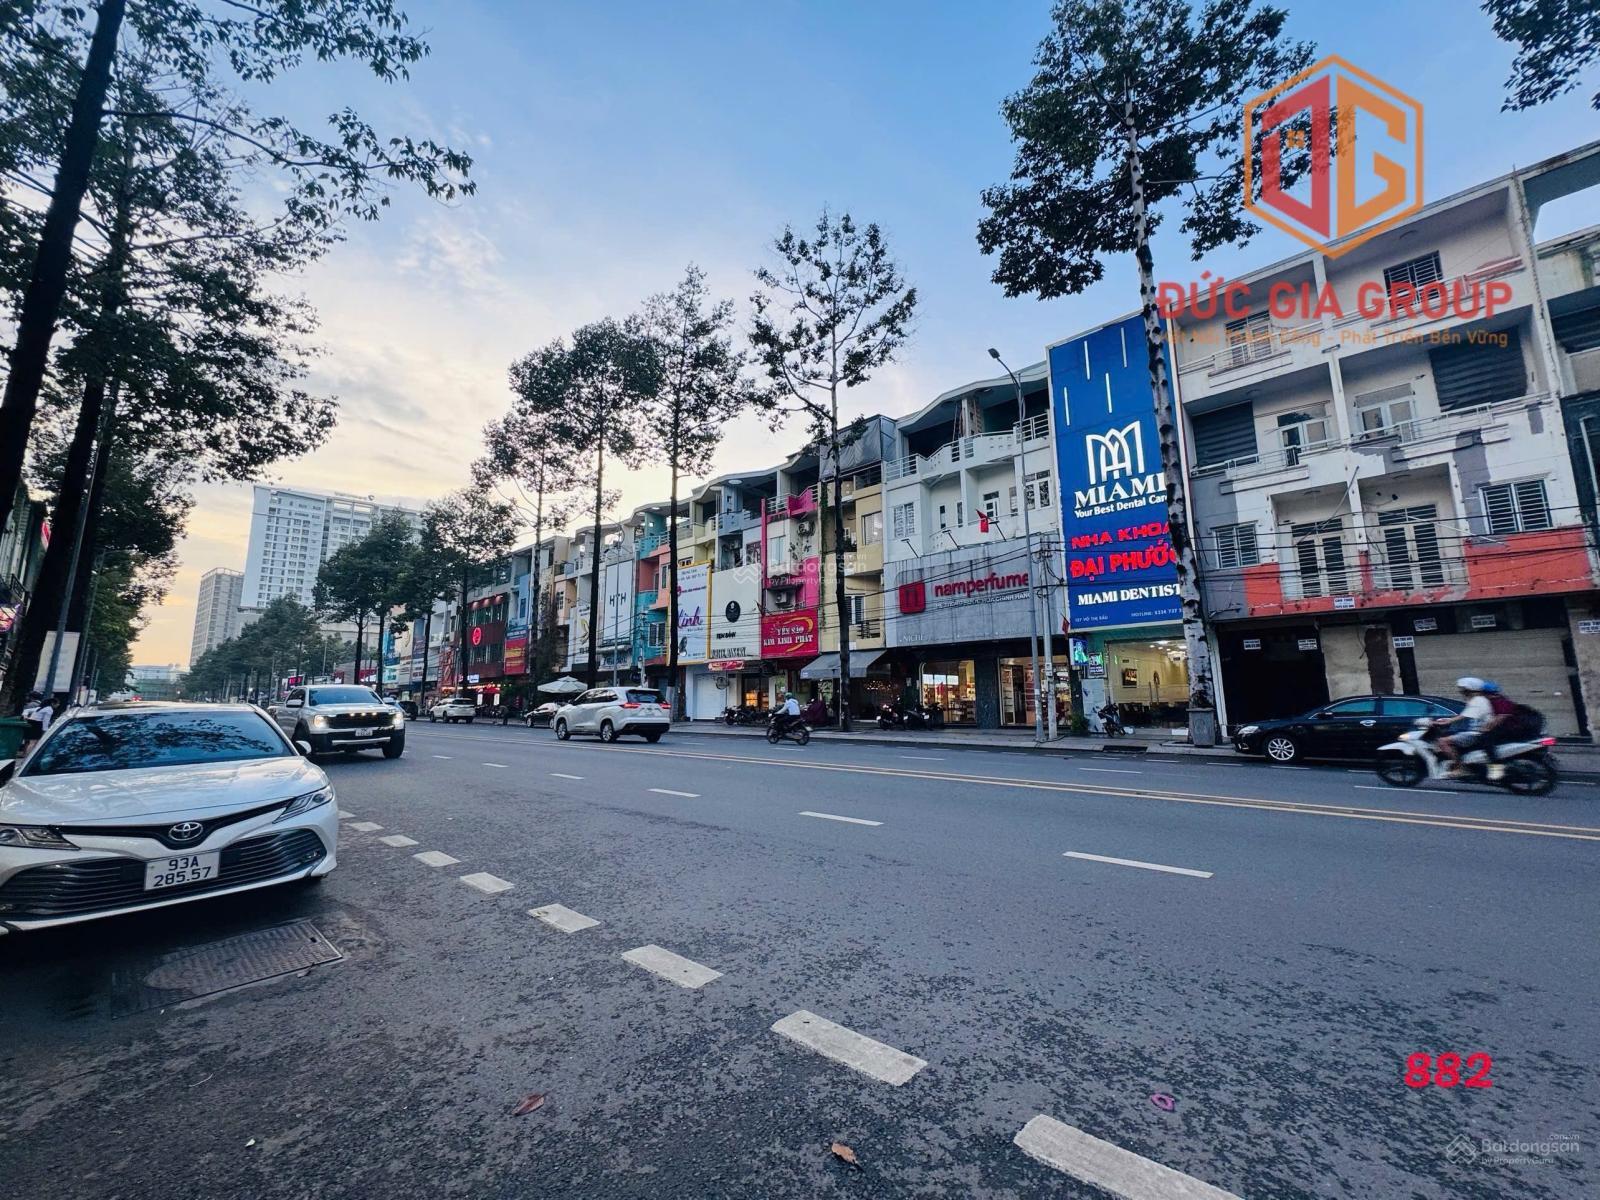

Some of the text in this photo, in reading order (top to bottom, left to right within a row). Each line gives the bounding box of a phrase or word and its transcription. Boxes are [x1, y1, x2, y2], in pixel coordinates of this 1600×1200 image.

[1074, 472, 1167, 509] MIAMI
[1074, 508, 1093, 518] Your
[1094, 504, 1115, 515] Best
[1117, 497, 1146, 511] Dental
[1071, 531, 1113, 550] NHA
[1070, 556, 1105, 581] ĐẠI
[934, 570, 1029, 598] namperfume
[1078, 583, 1181, 605] MIAMI DENTIST
[168, 855, 199, 871] 93A
[153, 866, 212, 887] 285.57
